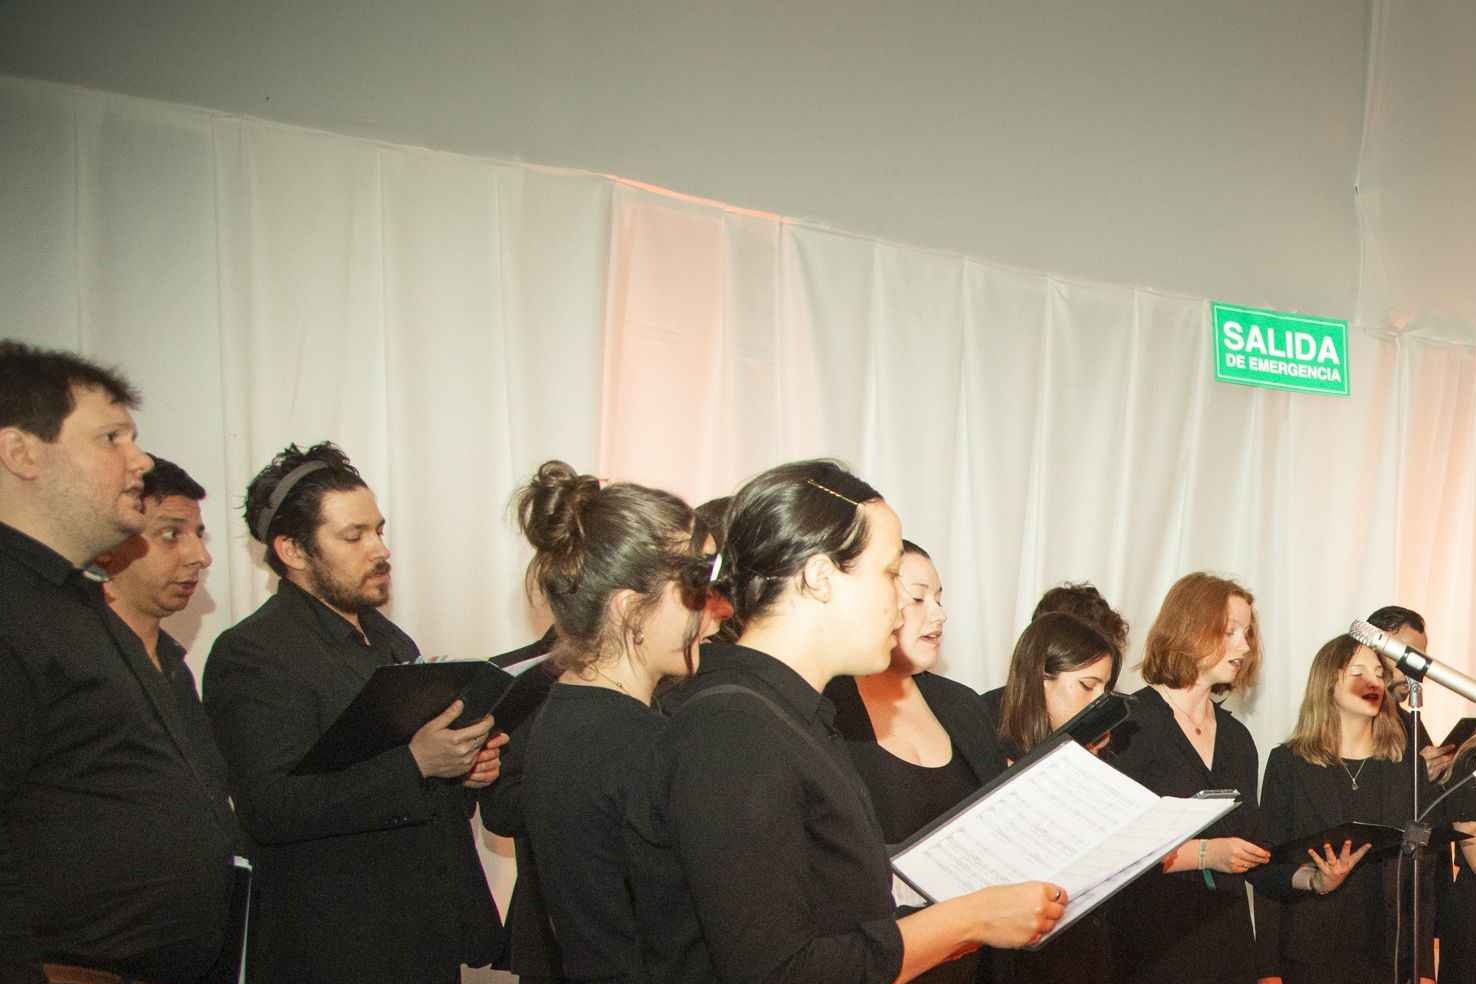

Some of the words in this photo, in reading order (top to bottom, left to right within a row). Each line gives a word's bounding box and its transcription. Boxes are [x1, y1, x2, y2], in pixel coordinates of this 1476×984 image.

[1223, 321, 1340, 365] SALIDA
[1225, 353, 1246, 369] DE
[1249, 357, 1341, 382] EMERGENCIA
